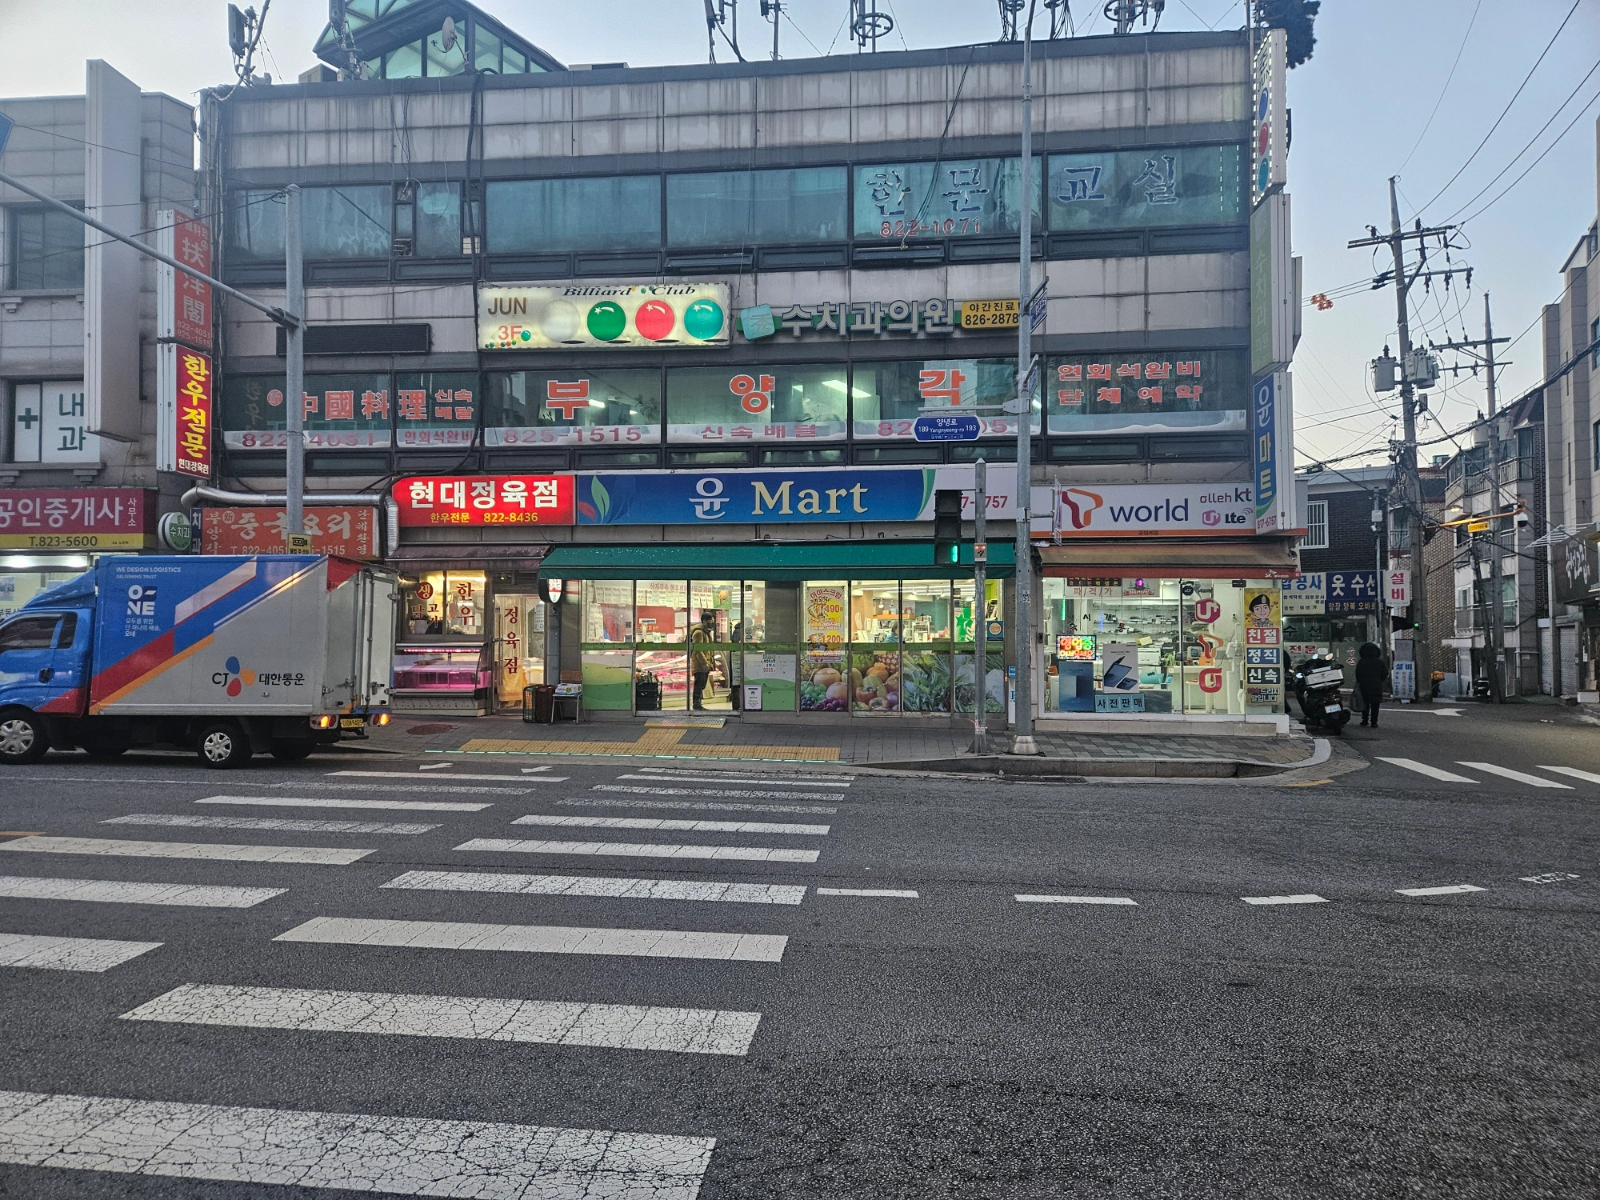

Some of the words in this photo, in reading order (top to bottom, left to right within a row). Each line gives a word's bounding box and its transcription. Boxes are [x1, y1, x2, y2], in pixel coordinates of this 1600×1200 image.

[1058, 154, 1179, 206] 교실
[879, 217, 981, 238] 822-1071
[563, 286, 633, 297] Billiard
[651, 285, 696, 297] Club
[487, 297, 527, 315] JUN
[781, 297, 955, 338] 수치과의원
[965, 313, 1019, 325] 826-2878
[497, 325, 523, 341] 3F
[434, 389, 473, 403] 신속
[546, 379, 590, 420] 부
[729, 374, 776, 414] 양
[918, 369, 966, 406] 각
[181, 354, 210, 459] 한우전문
[57, 392, 87, 452] 내과
[503, 426, 642, 444] 825-1515
[409, 480, 558, 509] 현대정육점
[688, 476, 731, 520] 윤
[751, 481, 869, 516] Mart
[1234, 487, 1253, 503] kt
[127, 497, 137, 527] 사무소
[430, 512, 470, 523] 한우전문
[483, 512, 539, 523] 822-8436
[1109, 498, 1189, 523] world
[170, 526, 190, 538] 수치과
[29, 536, 98, 547] T.823-5600
[1390, 572, 1405, 601] 설비
[456, 582, 475, 626] 한우
[504, 605, 520, 675] 정육점
[1060, 636, 1093, 651] 영업중
[1247, 628, 1278, 643] 친절
[1247, 649, 1277, 663] 정직
[212, 672, 229, 687] CJ
[259, 672, 305, 686] 대한통운
[1248, 668, 1278, 683] 신속
